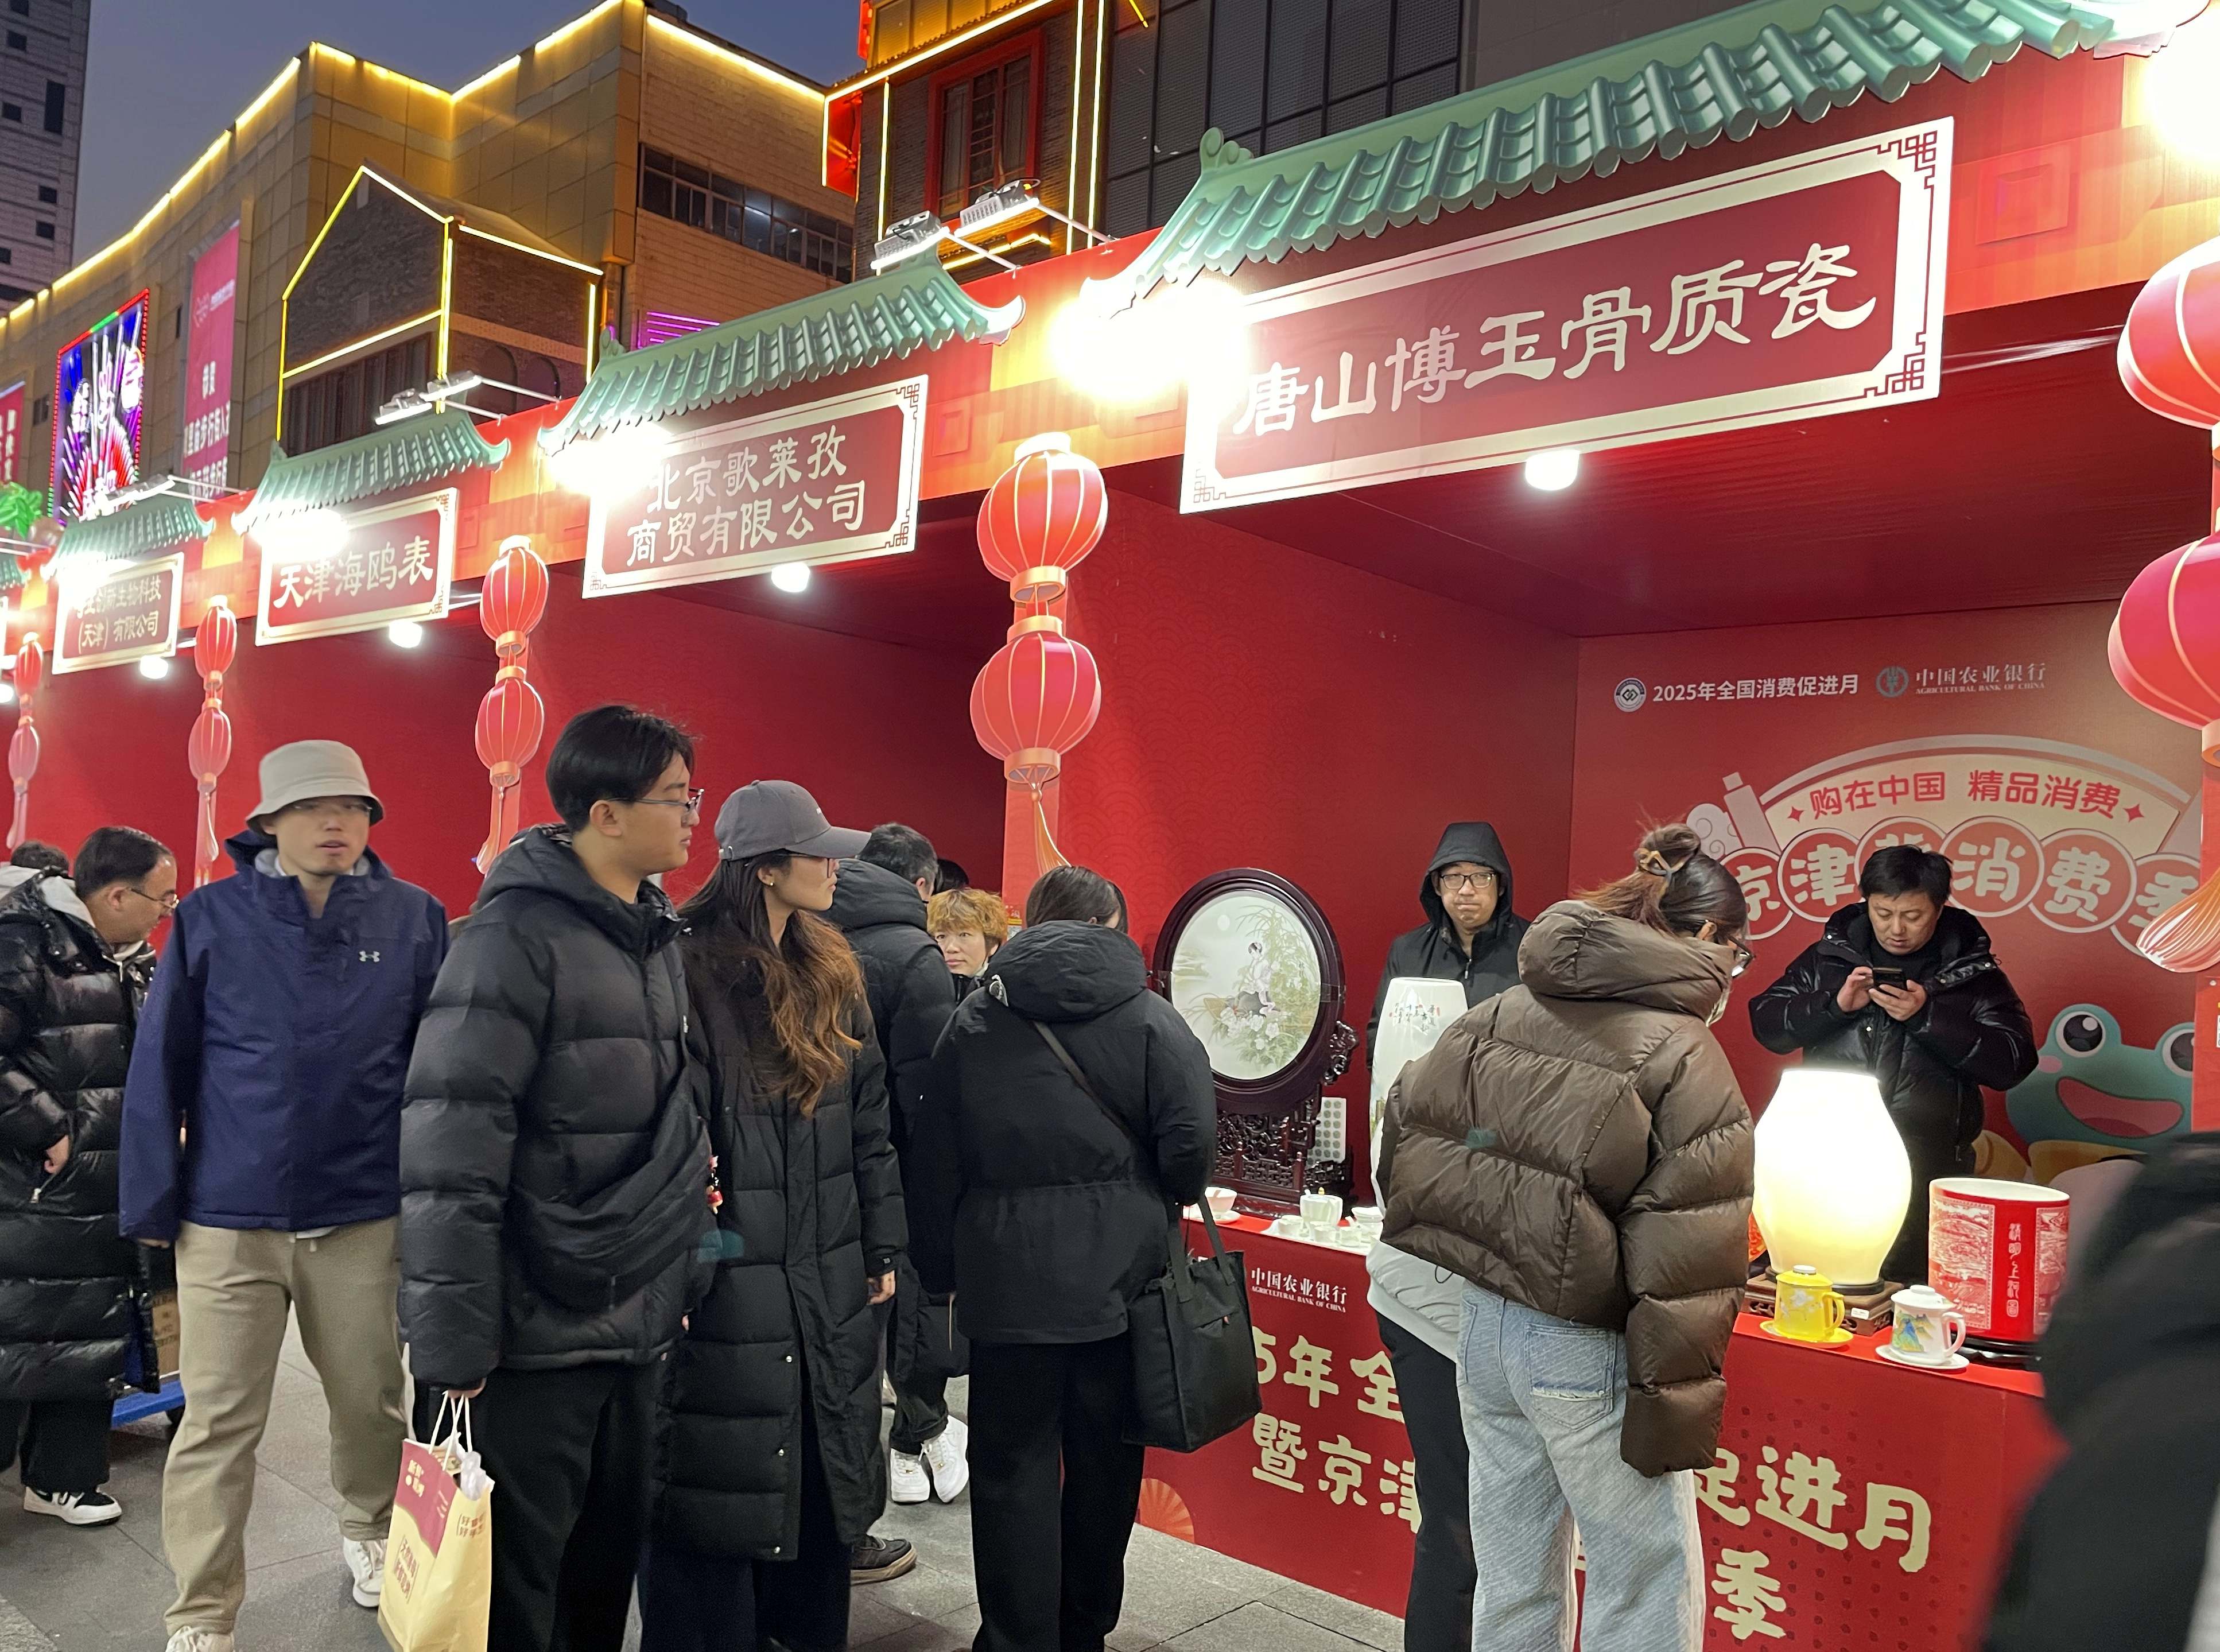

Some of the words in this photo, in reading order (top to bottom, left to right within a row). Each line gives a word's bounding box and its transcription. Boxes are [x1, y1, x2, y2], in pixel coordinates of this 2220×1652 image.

[1233, 243, 1876, 436] 唐山博玉骨质瓷
[647, 425, 847, 514] 北京歌莱孜
[627, 480, 866, 566] 商贸有限公司
[273, 535, 433, 608] 天津海鸥表
[1653, 674, 1859, 702] 2025年全国消费促进月
[1915, 685, 1976, 695] AGRICULTURAL
[1978, 684, 2001, 692] BANK
[2018, 682, 2045, 690] CHINA
[1916, 663, 2046, 687] 中国农业银行
[1810, 771, 1946, 820] 购在中国
[1968, 770, 2121, 819] 精品消费
[1736, 833, 2199, 929] 京津消费
[1251, 1267, 1347, 1304] 中国农业银行
[1251, 1285, 1296, 1301] AGRICULTURAL
[1297, 1295, 1314, 1306] BANK
[1326, 1302, 1346, 1313] CHINA
[1711, 1548, 1787, 1640] 季
